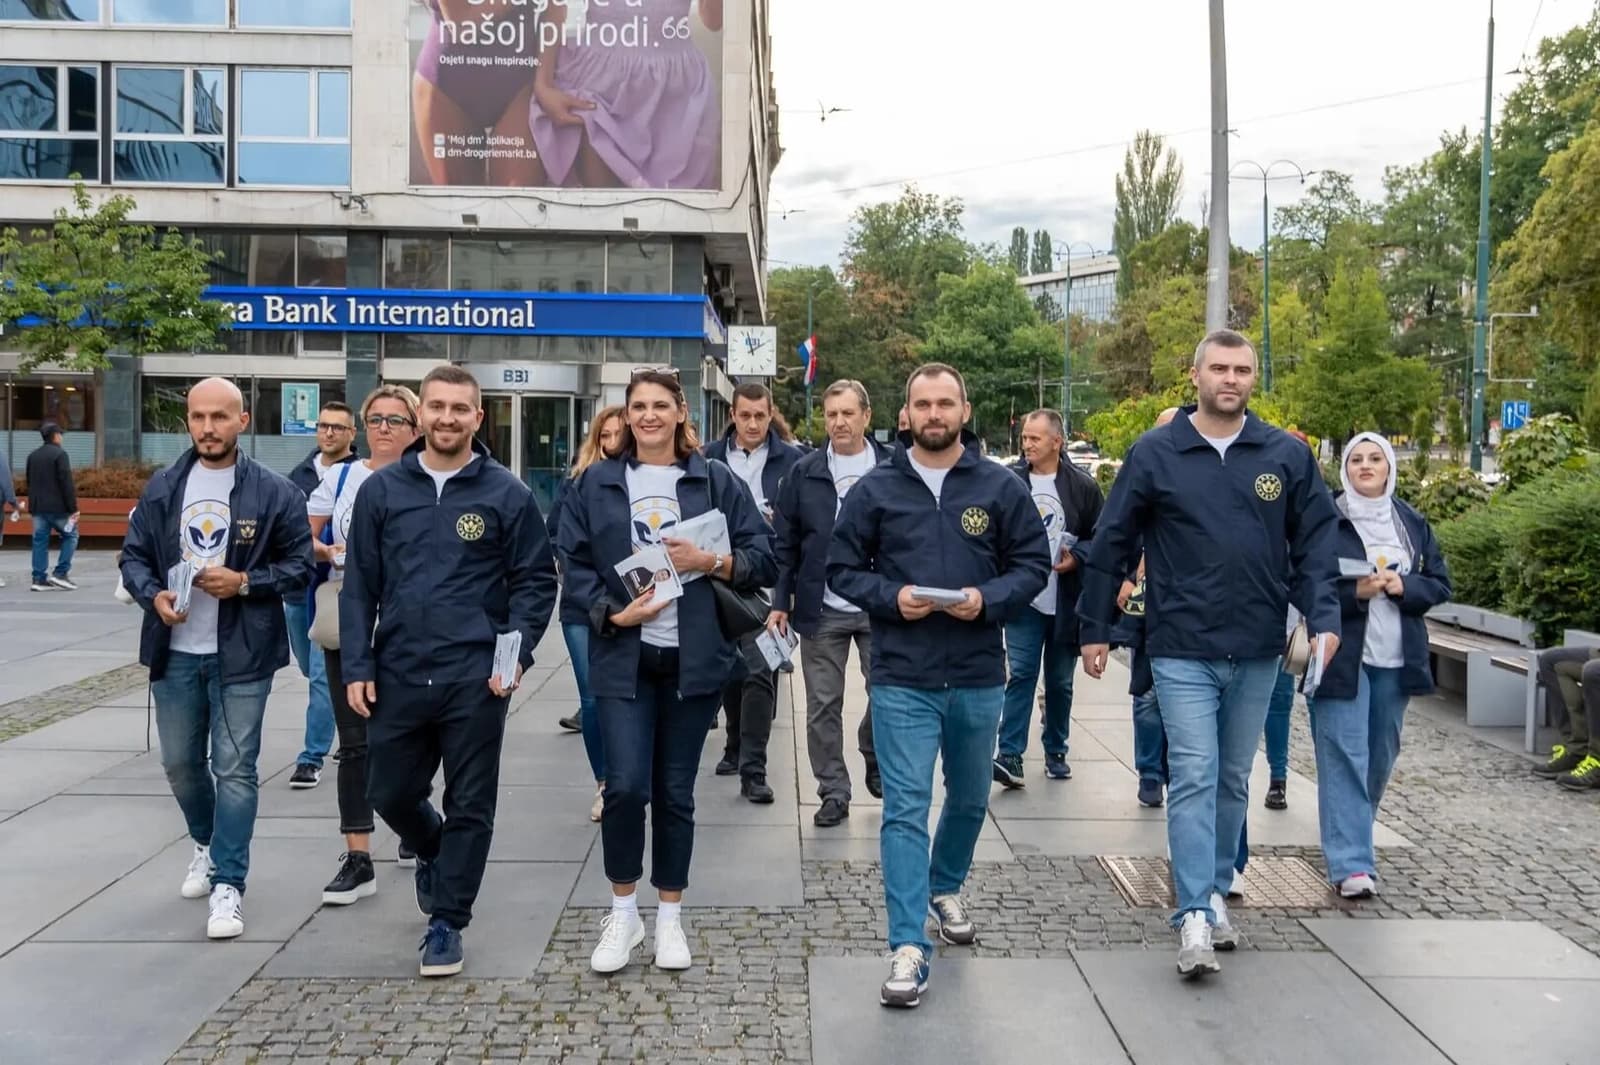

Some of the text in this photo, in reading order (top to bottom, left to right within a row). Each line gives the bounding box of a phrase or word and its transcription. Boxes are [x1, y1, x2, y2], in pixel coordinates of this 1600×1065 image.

[439, 12, 525, 53] našoj
[439, 55, 542, 67] Osjeti snagu inspiracije.
[486, 135, 525, 147] aplikacija
[447, 147, 537, 160] dm-drogeriemarkt.ba
[264, 295, 338, 324] Bank
[346, 297, 536, 328] International
[503, 369, 529, 383] BBI
